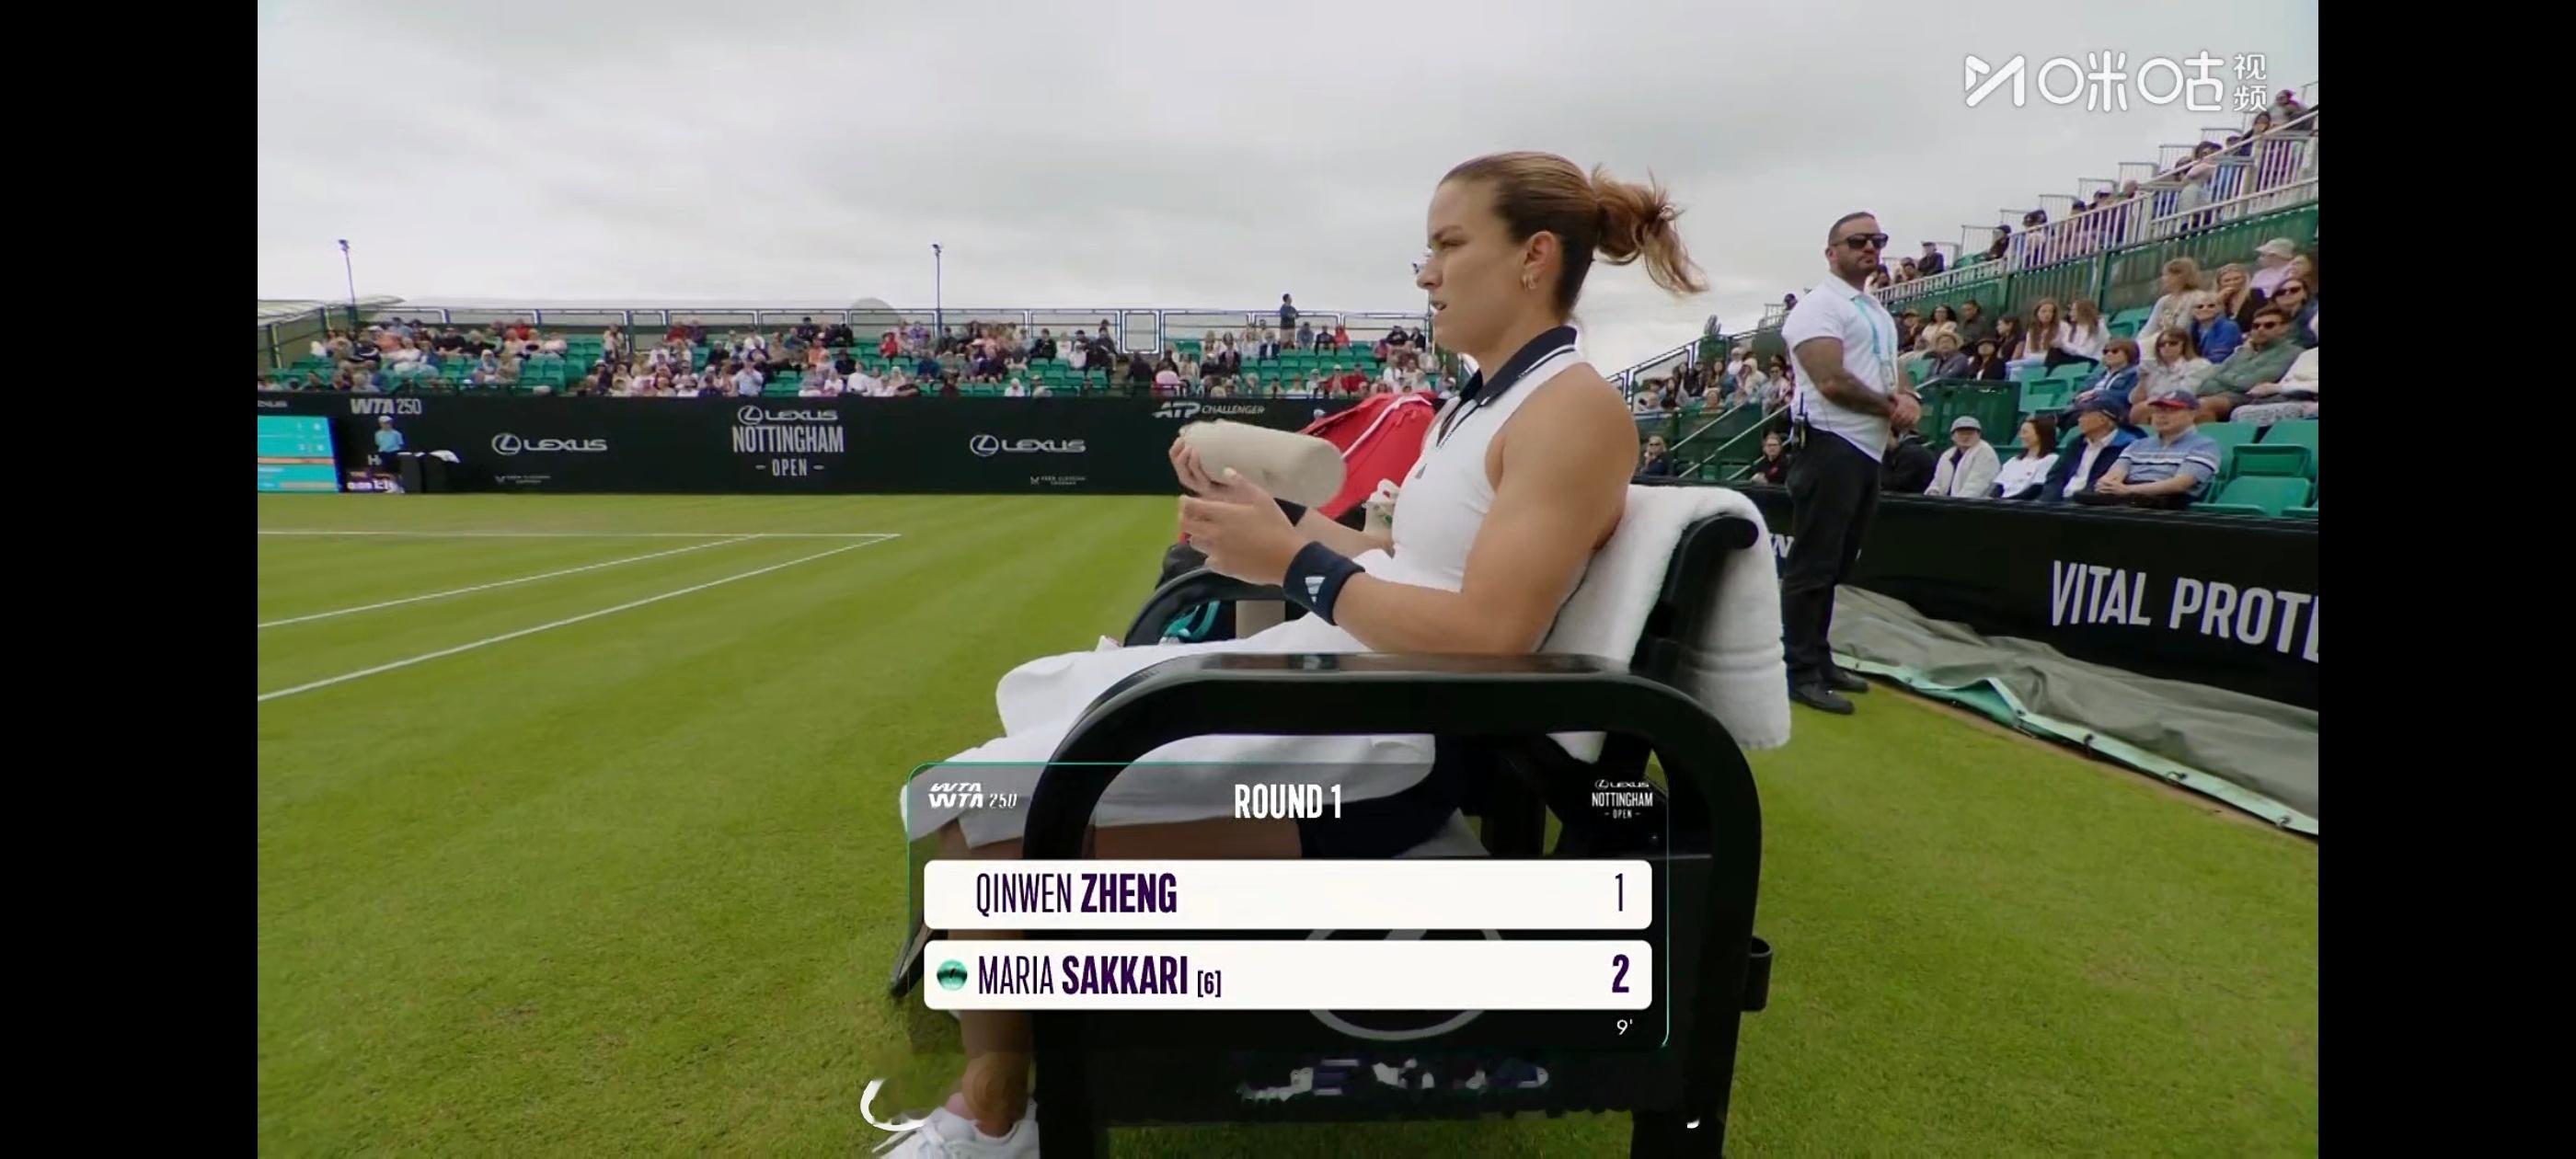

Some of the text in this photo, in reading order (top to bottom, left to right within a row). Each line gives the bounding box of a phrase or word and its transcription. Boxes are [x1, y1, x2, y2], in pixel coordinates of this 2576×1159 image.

[351, 397, 422, 415] WTA 250
[765, 409, 838, 421] LEXUS
[1152, 401, 1265, 419] ATP CHALLENGER
[523, 439, 608, 452] LEXUS
[732, 426, 845, 453] NOTTINGHAM
[1001, 439, 1087, 453] LEXUS
[772, 458, 808, 476] OPEN
[2052, 559, 2152, 626] VITAL
